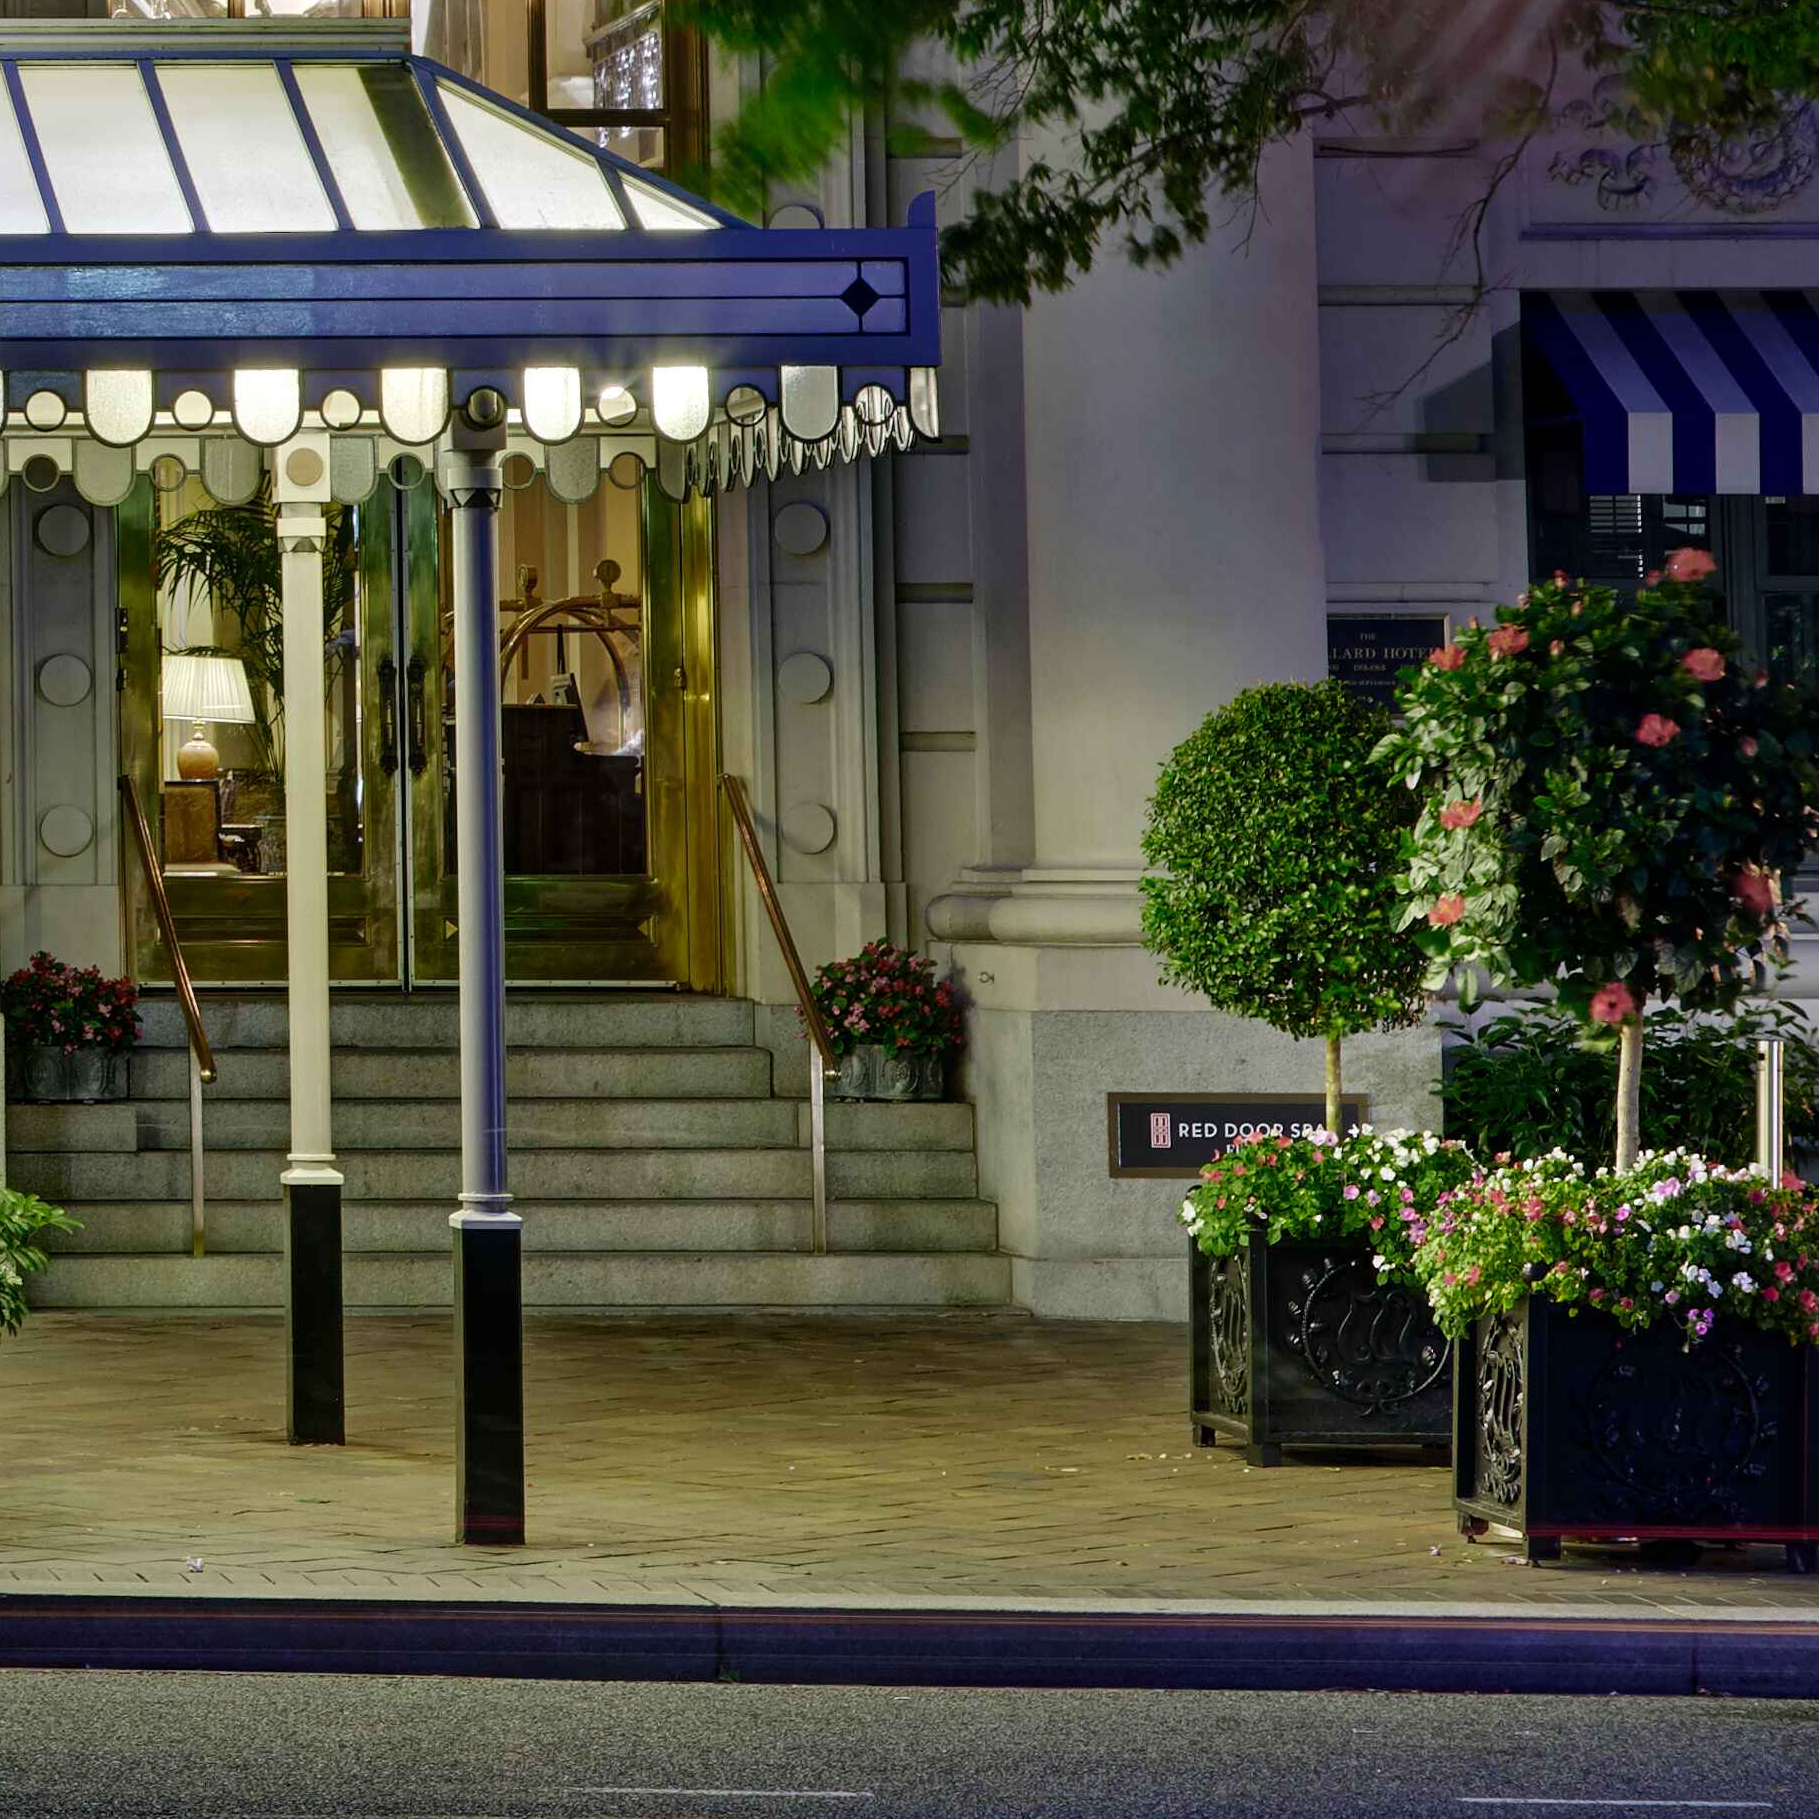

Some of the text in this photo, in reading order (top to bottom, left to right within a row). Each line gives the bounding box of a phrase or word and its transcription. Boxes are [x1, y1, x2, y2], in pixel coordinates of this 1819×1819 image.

[1328, 647, 1376, 660] LARD
[1179, 1123, 1218, 1138] RED
[1225, 1123, 1284, 1138] DOOR
